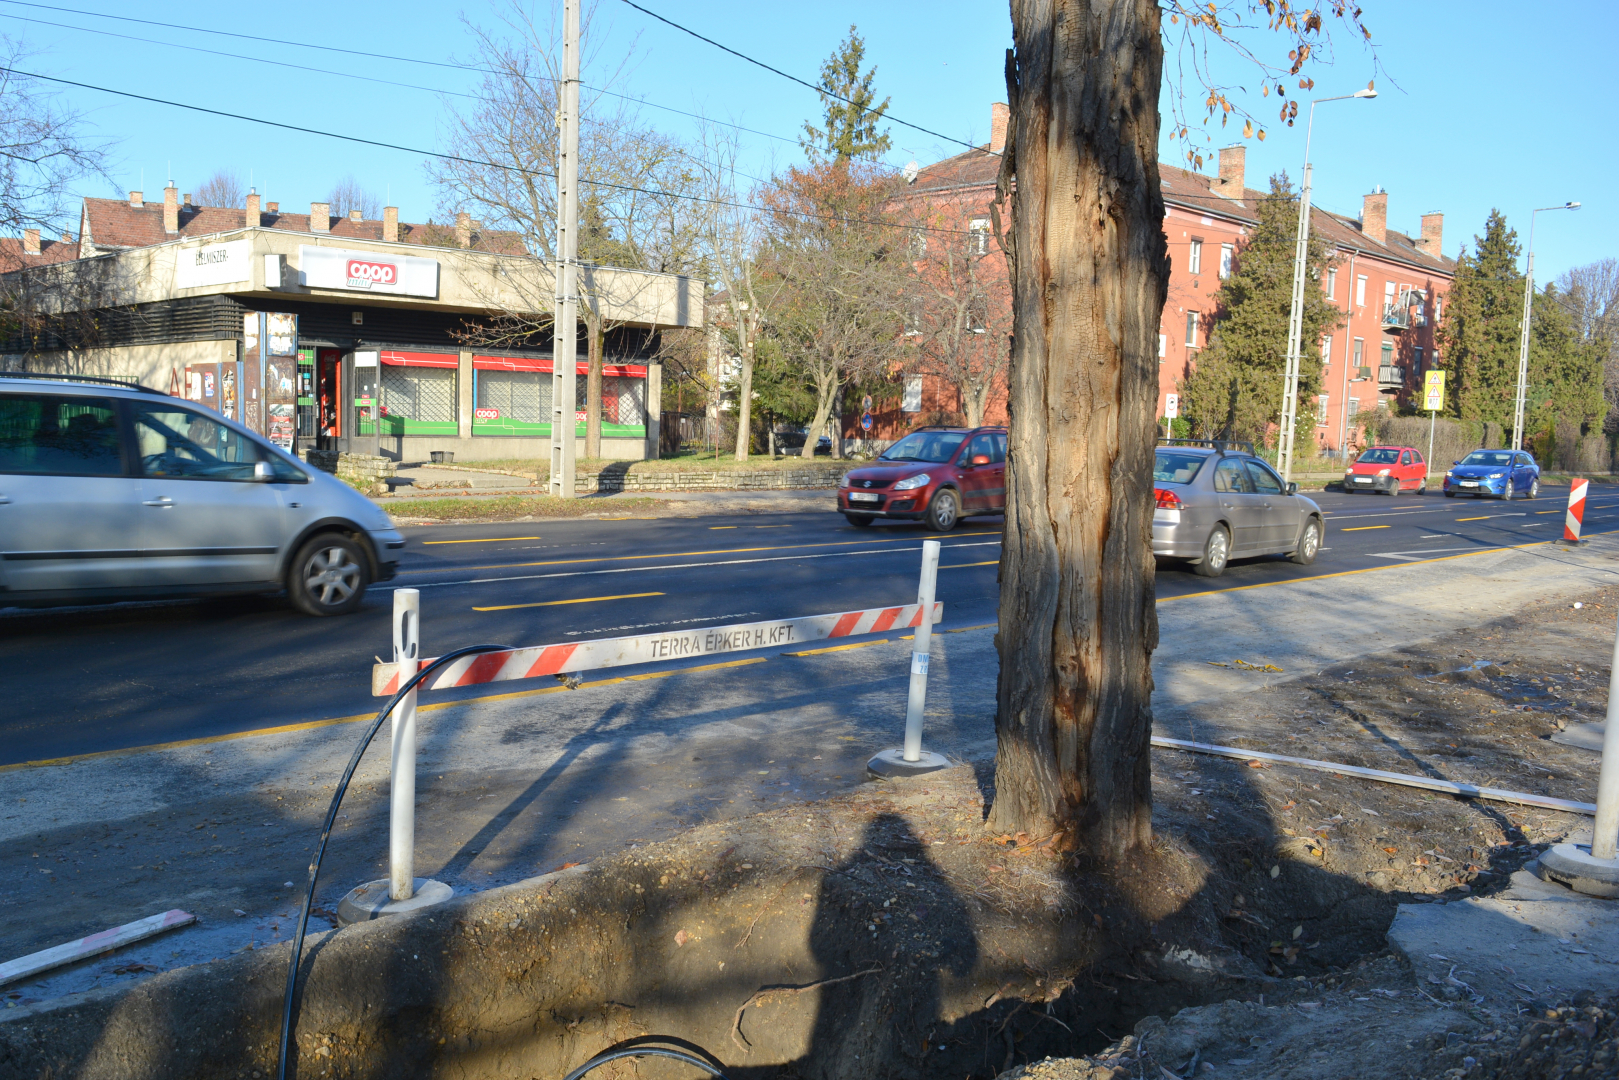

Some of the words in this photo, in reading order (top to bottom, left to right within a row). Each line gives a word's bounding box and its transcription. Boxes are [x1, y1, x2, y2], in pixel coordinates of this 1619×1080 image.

[350, 263, 393, 283] coop
[476, 410, 498, 419] coop
[576, 412, 587, 421] oop
[651, 635, 701, 658] TERRA
[705, 629, 751, 651] ÉPKER
[754, 628, 766, 645] H.
[769, 625, 794, 643] KFT.
